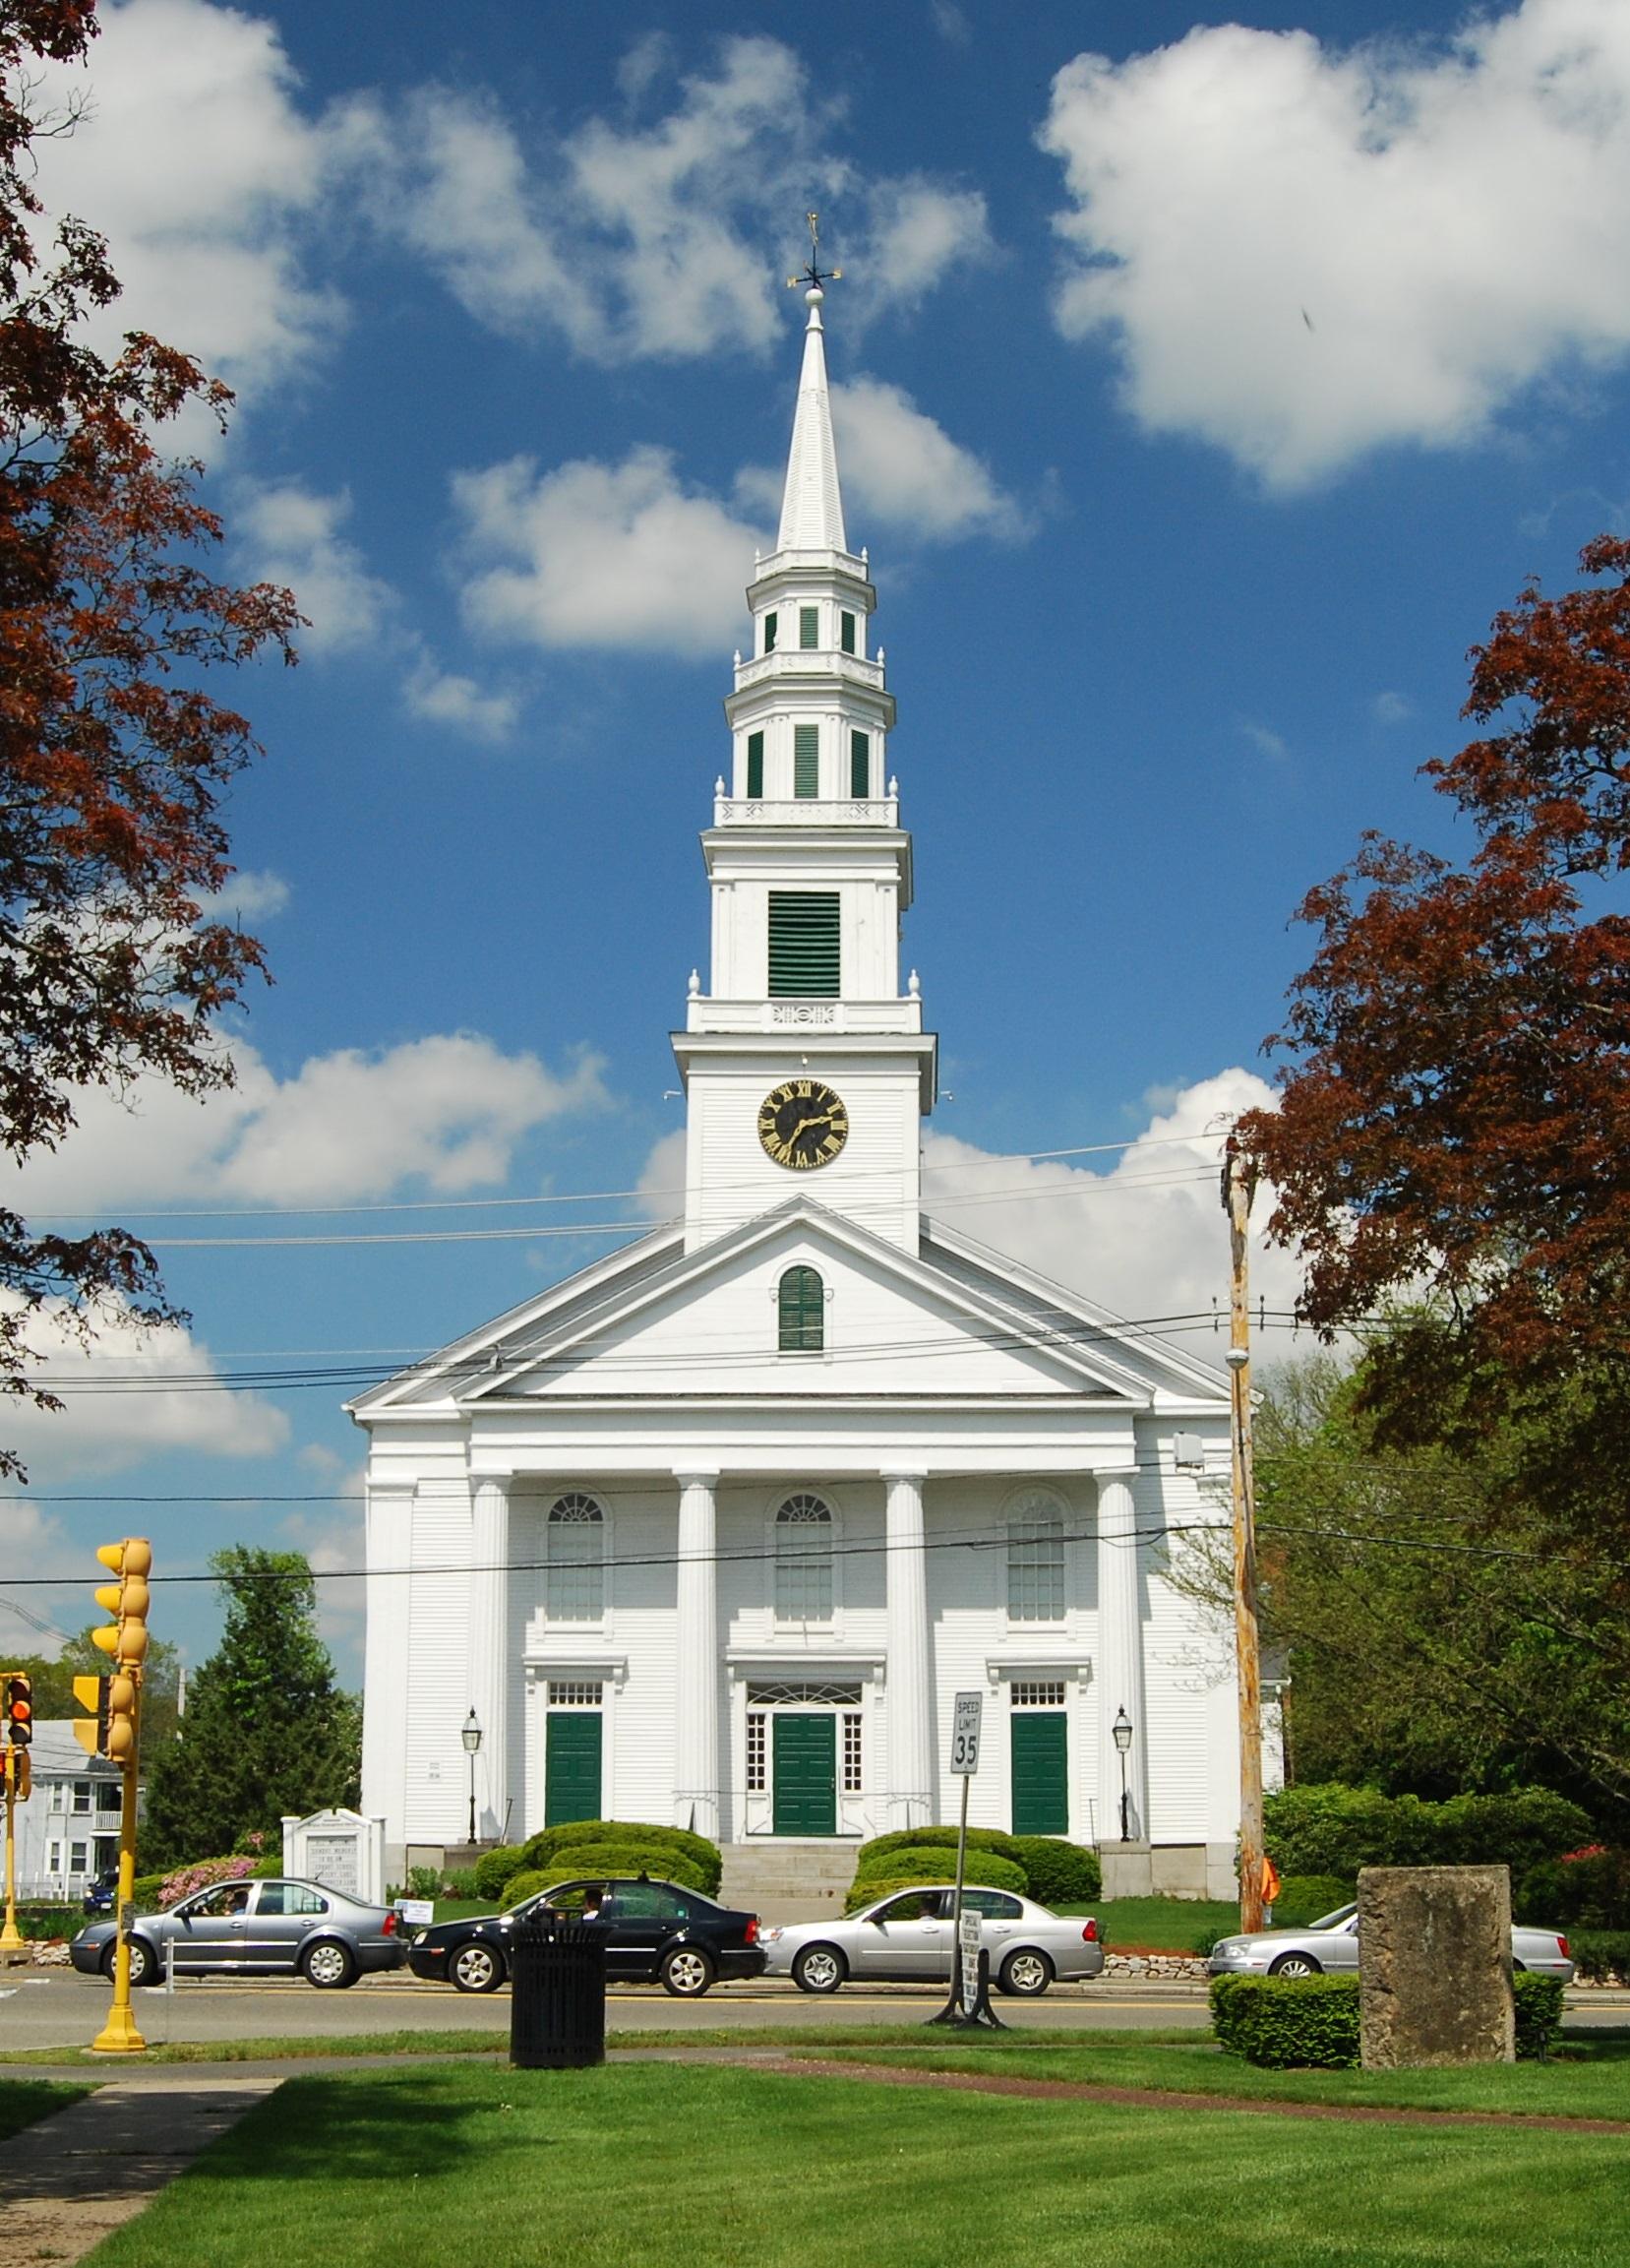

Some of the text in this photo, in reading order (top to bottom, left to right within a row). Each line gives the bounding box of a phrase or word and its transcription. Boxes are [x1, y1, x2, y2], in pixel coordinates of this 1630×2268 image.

[778, 1085, 795, 1103] XI
[797, 1081, 812, 1098] XII
[817, 1088, 827, 1101] I
[763, 1099, 781, 1113] X
[826, 1102, 843, 1115] II
[758, 1118, 776, 1130] IX
[830, 1120, 848, 1131] III
[763, 1133, 781, 1151] VIII
[796, 1149, 809, 1165] VI
[958, 1701, 979, 1714] SPEED
[959, 1718, 976, 1731] LIMIT
[955, 1735, 977, 1764] 35
